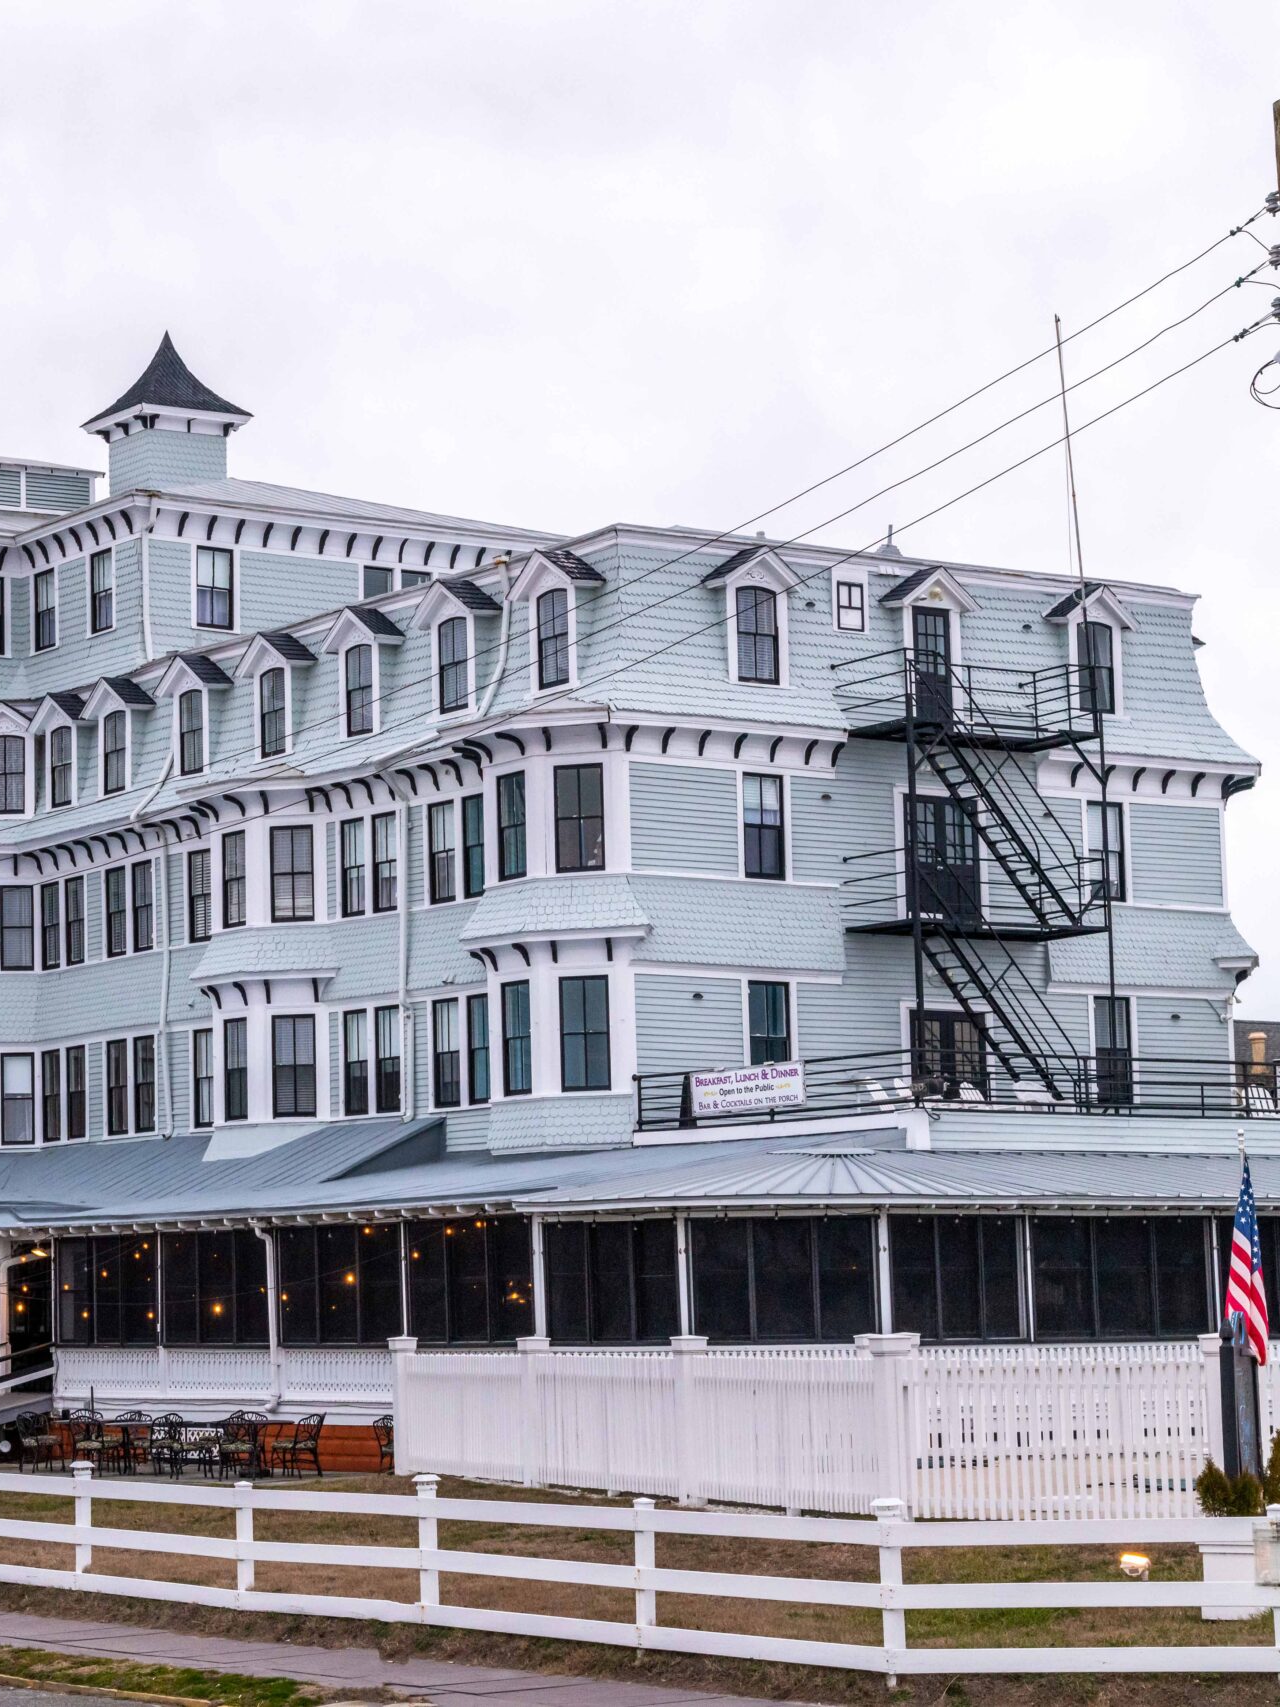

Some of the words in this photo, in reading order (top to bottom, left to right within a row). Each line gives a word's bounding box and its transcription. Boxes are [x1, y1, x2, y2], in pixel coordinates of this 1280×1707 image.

[735, 1072, 759, 1083] LUNCH
[761, 1069, 769, 1080] &
[771, 1068, 799, 1079] DINNER
[719, 1088, 735, 1097] Open
[744, 1085, 753, 1093] the
[755, 1083, 774, 1092] Public
[698, 1101, 711, 1111] BAR
[712, 1100, 719, 1109] &
[720, 1099, 752, 1108] COCKTAILS
[778, 1094, 799, 1103] PORCH
